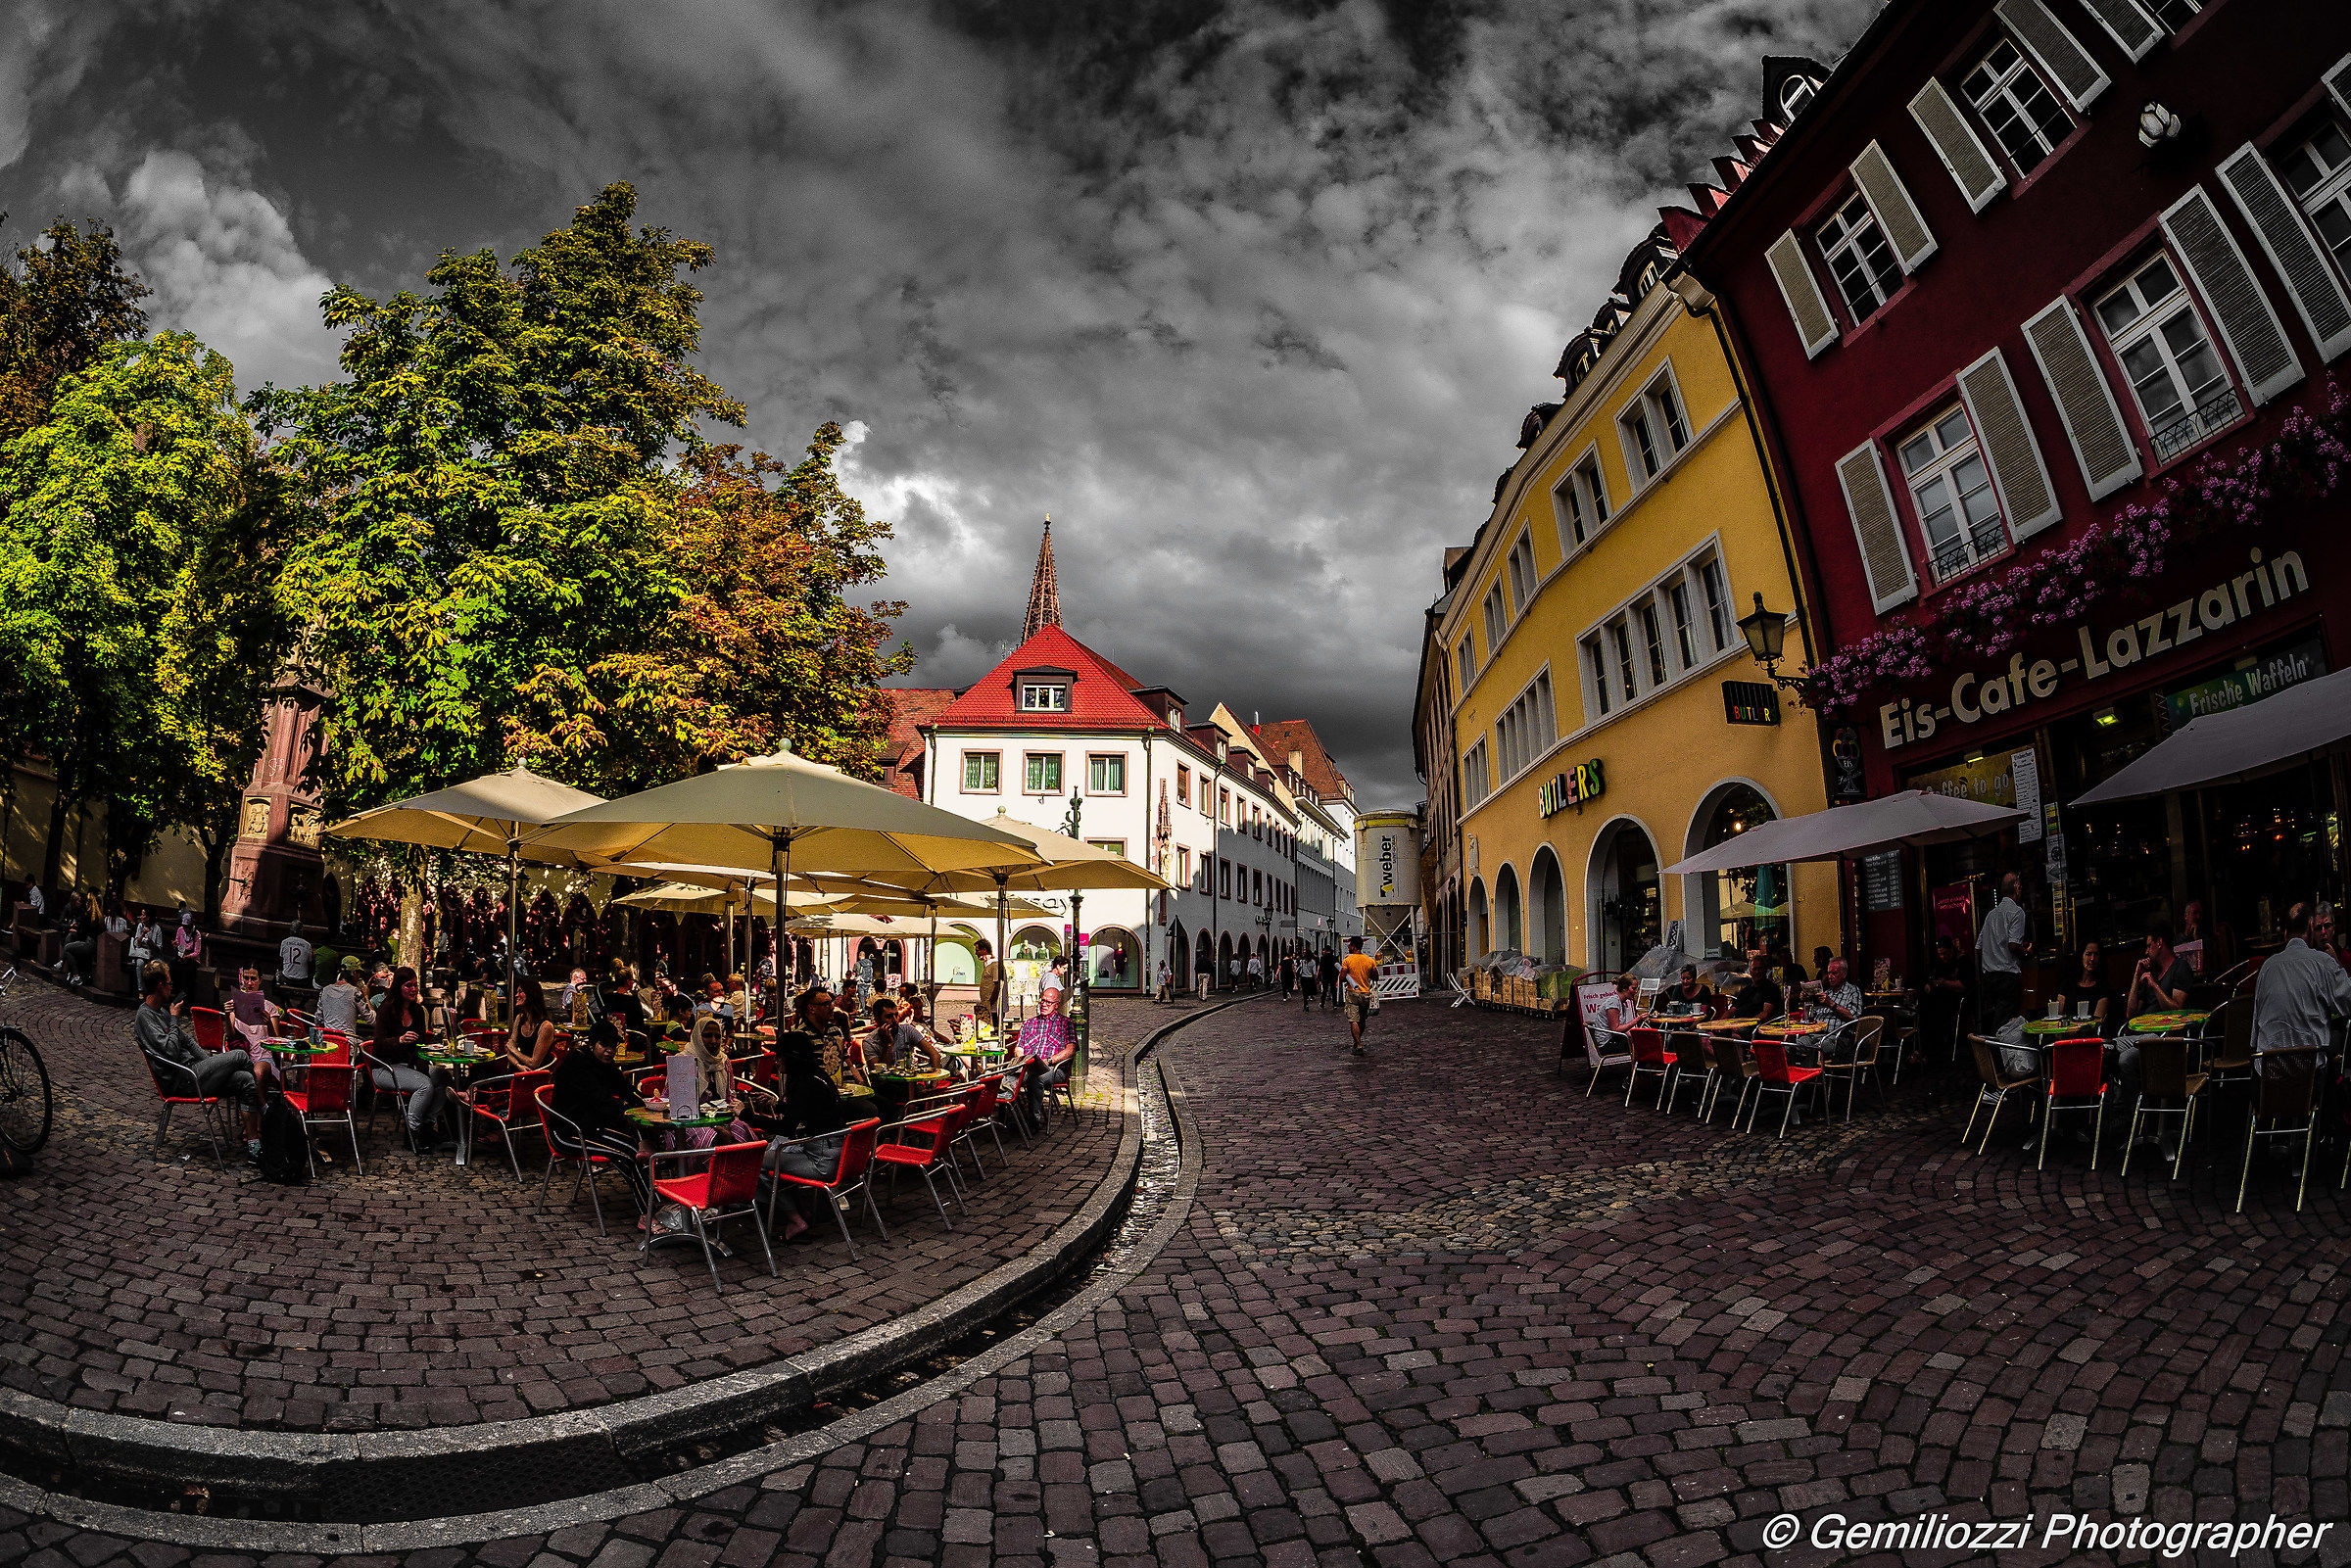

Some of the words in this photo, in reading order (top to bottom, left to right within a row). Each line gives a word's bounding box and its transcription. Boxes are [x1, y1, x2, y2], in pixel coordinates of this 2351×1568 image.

[1879, 546, 2309, 749] Eis-Cafe-Lazzarin
[2188, 680, 2243, 716] Frische
[2245, 653, 2308, 696] Waffeln
[1538, 759, 1601, 820] BUTLERS
[1973, 776, 1988, 796] to
[1993, 772, 2010, 797] go
[1378, 834, 1393, 885] weber
[289, 947, 301, 965] 12
